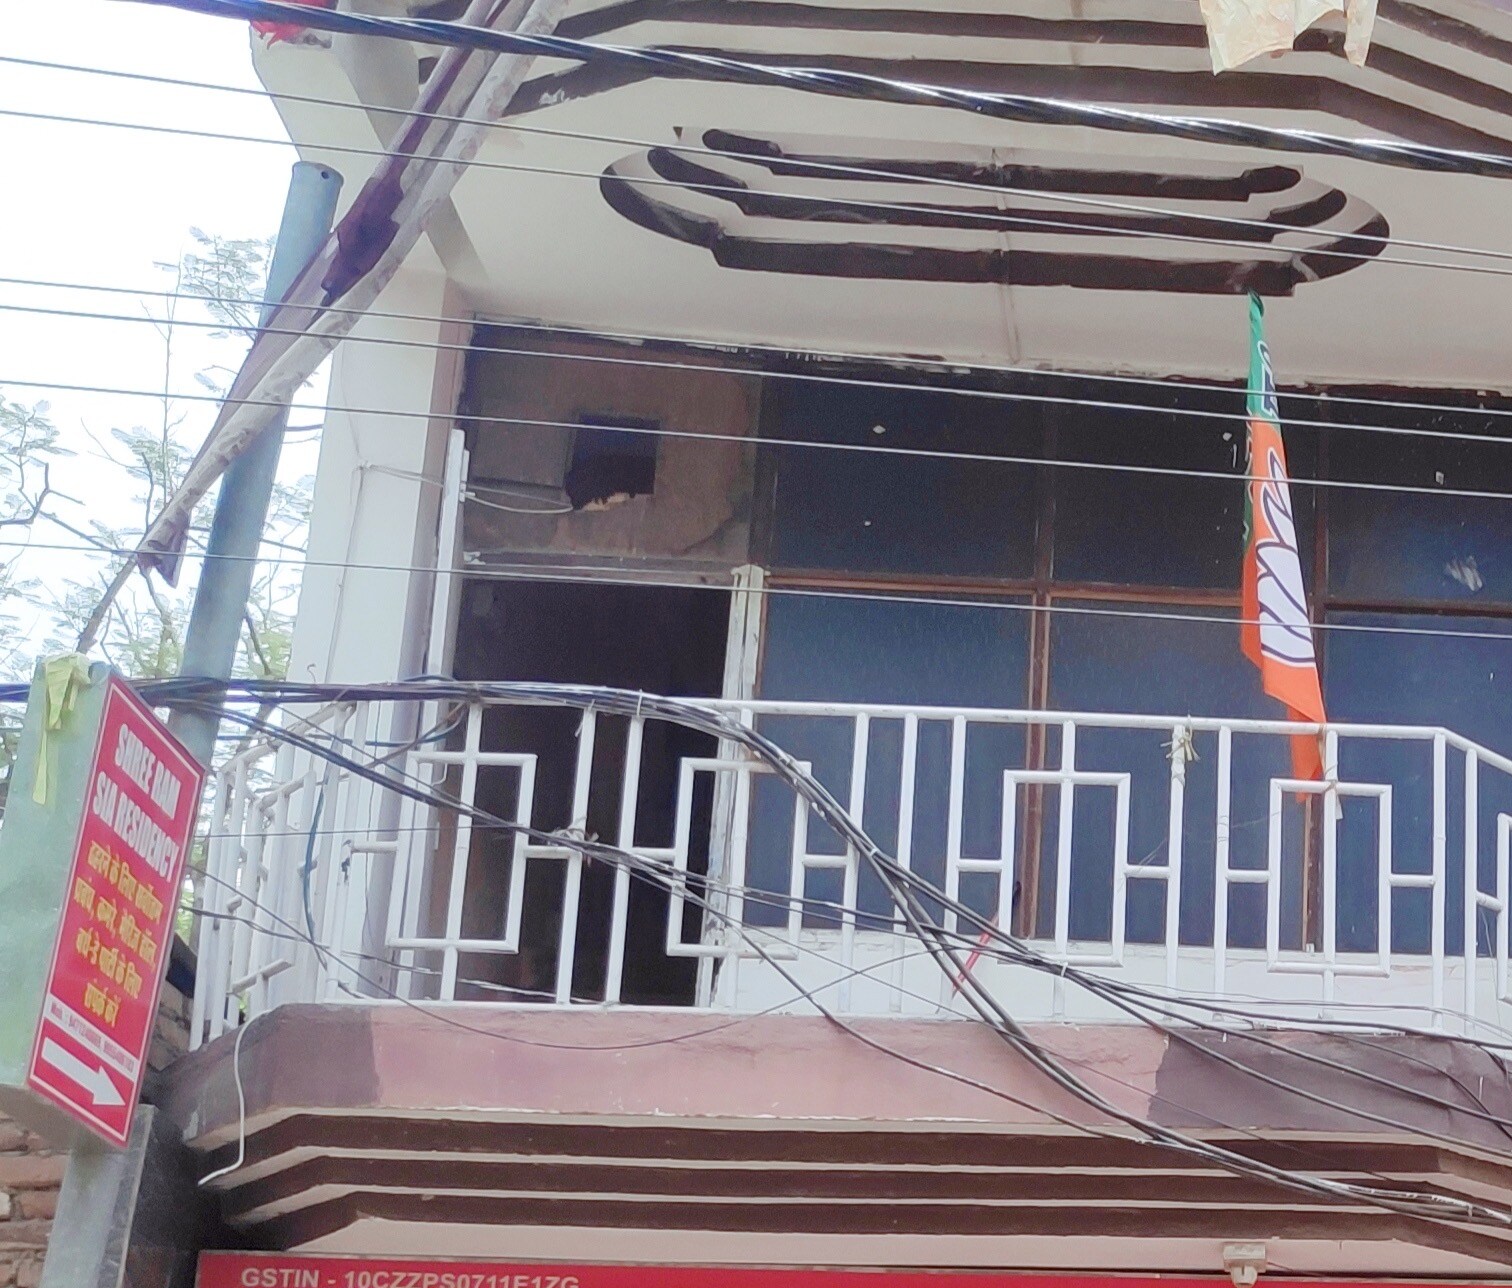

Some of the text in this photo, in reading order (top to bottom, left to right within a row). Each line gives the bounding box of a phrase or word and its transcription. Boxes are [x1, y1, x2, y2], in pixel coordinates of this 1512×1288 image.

[115, 724, 180, 818] SHREE RAM
[92, 772, 178, 880] SIA RESIDENCY
[241, 1268, 319, 1288] GSTIN
